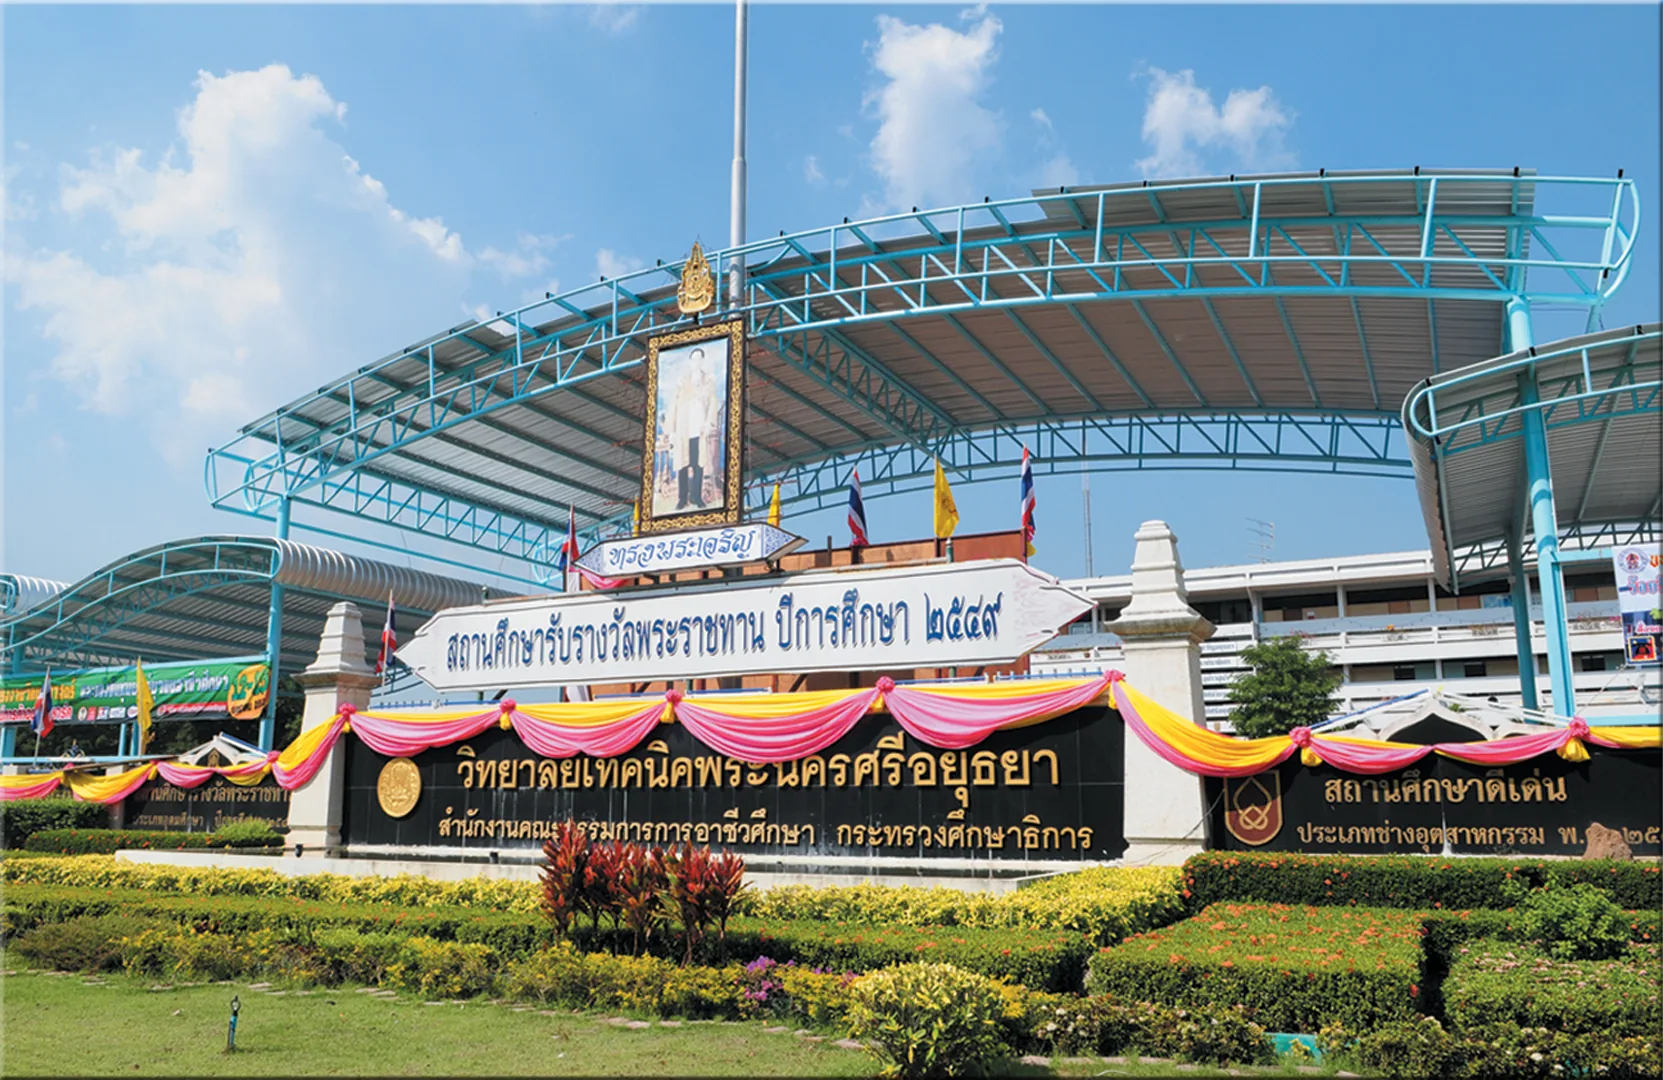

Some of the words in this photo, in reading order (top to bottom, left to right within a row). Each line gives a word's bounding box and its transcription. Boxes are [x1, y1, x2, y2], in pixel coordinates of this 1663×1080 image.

[609, 527, 756, 570] ทรงพระเจริญ
[446, 606, 766, 672] สถานศึกษารับรางวัลพระราชทาน
[775, 587, 911, 652] ปีการศึกษา
[924, 592, 1003, 643] ๒๕๔๙
[457, 732, 1059, 808] วิทยาลยเทคนิคพระนครศรีอยุธยา
[1325, 768, 1567, 803] สถานศึกษาดีเด่น
[439, 805, 815, 845] สำนักงานคณะรรมการการอาชีวศึกษา
[837, 808, 1094, 849] กระทรวงศึกษาธิการ
[1297, 820, 1545, 853] ประเภทช่างอุตสาหกรรม
[1622, 826, 1663, 845] ๒๕
